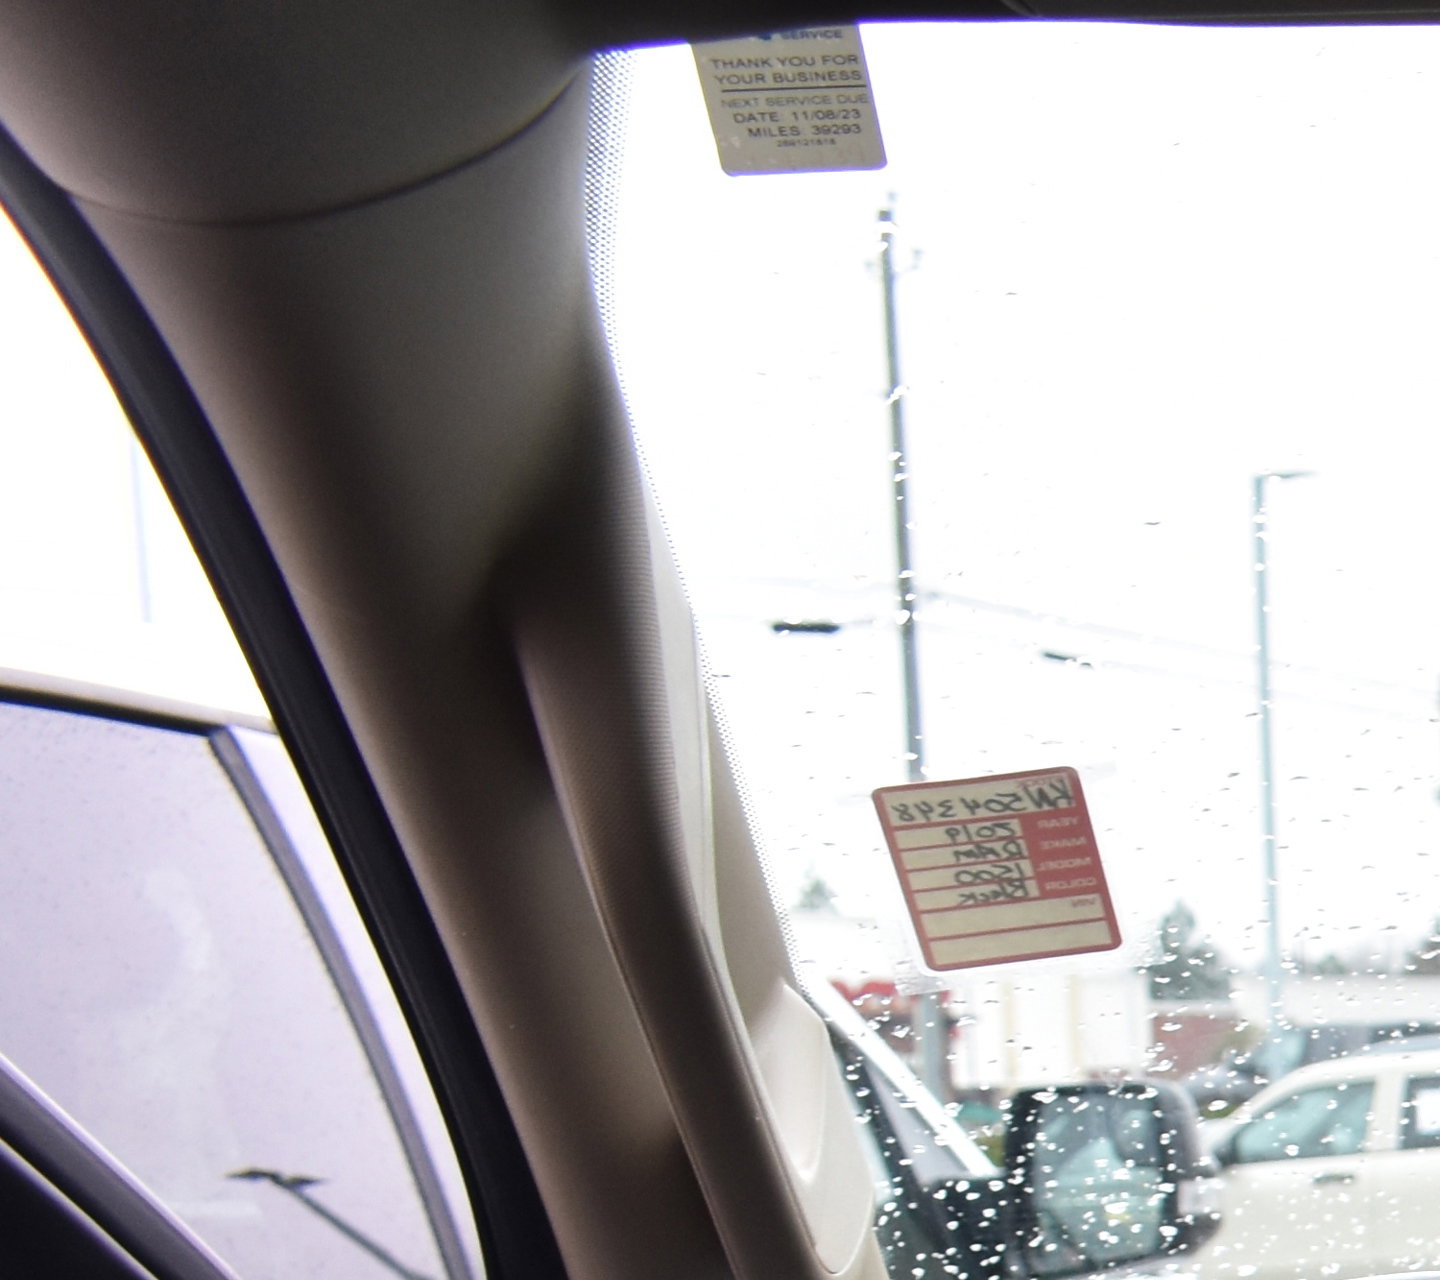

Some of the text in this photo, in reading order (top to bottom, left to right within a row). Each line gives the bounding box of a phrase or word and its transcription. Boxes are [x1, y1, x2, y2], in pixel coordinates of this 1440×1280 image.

[780, 29, 843, 40] SERVICE
[710, 54, 859, 70] THANK YOU FOR
[713, 70, 863, 86] YOUR BUSINESS
[720, 93, 870, 109] NEXT SERVICE DUE
[791, 108, 862, 121] 11/08/23
